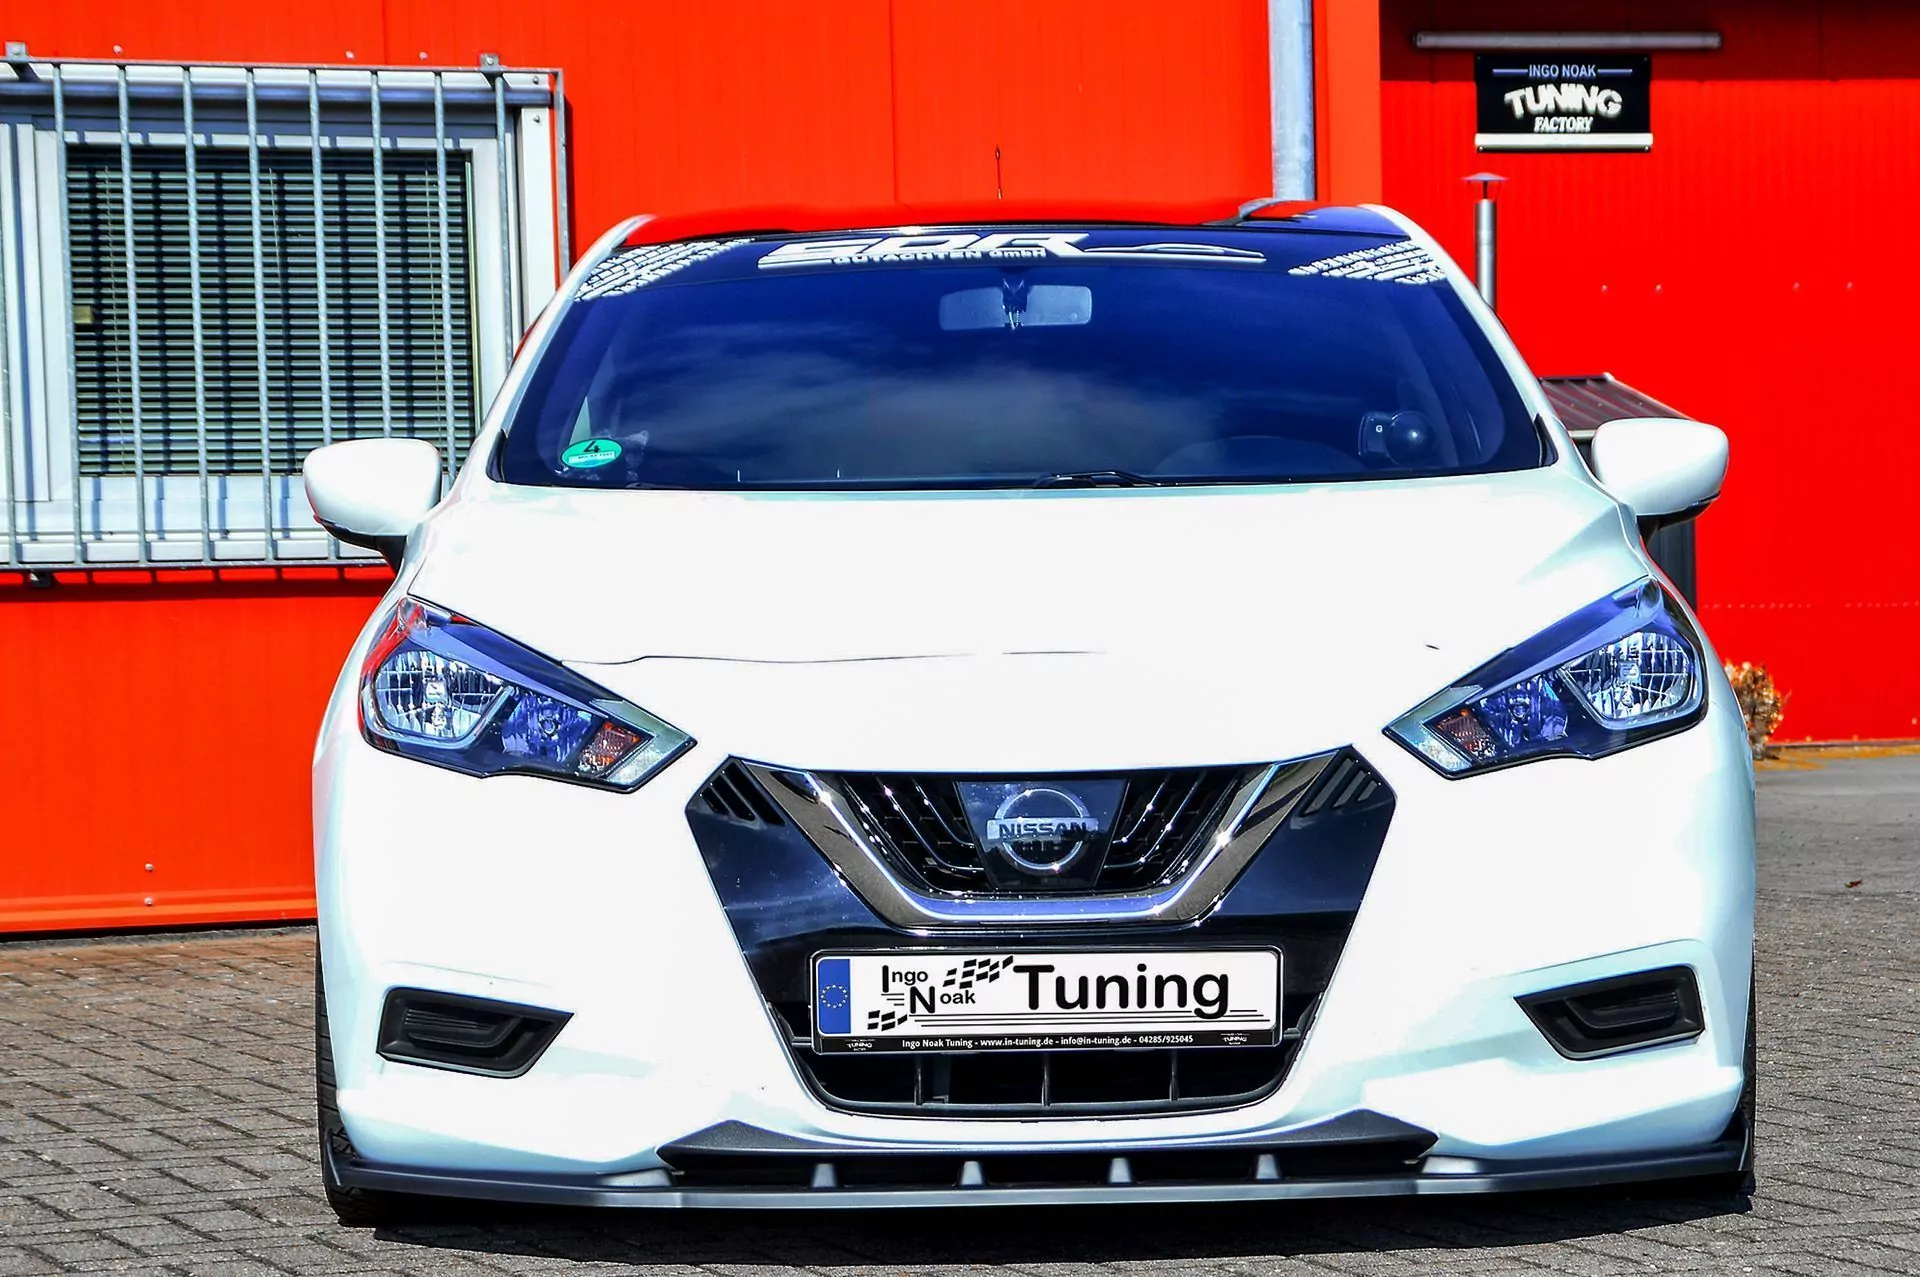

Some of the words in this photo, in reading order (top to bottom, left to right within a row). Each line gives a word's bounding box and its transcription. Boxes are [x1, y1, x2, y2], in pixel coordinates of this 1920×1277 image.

[1529, 64, 1559, 78] INGO
[1562, 64, 1597, 78] NOAK
[1504, 83, 1623, 119] TUNING
[1534, 116, 1593, 133] FACTORY
[999, 822, 1087, 837] NISSAN
[882, 964, 929, 993] Ingo
[909, 985, 977, 1014] Noak
[1012, 963, 1230, 1020] Tuning
[902, 1039, 920, 1049] Ingo
[922, 1039, 944, 1048] Noak
[945, 1038, 973, 1049] Tuning
[980, 1036, 1054, 1047] www.in-tuning.de
[1060, 1035, 1132, 1046] info@in-tuning.de
[1138, 1034, 1194, 1044] 04285/925045
